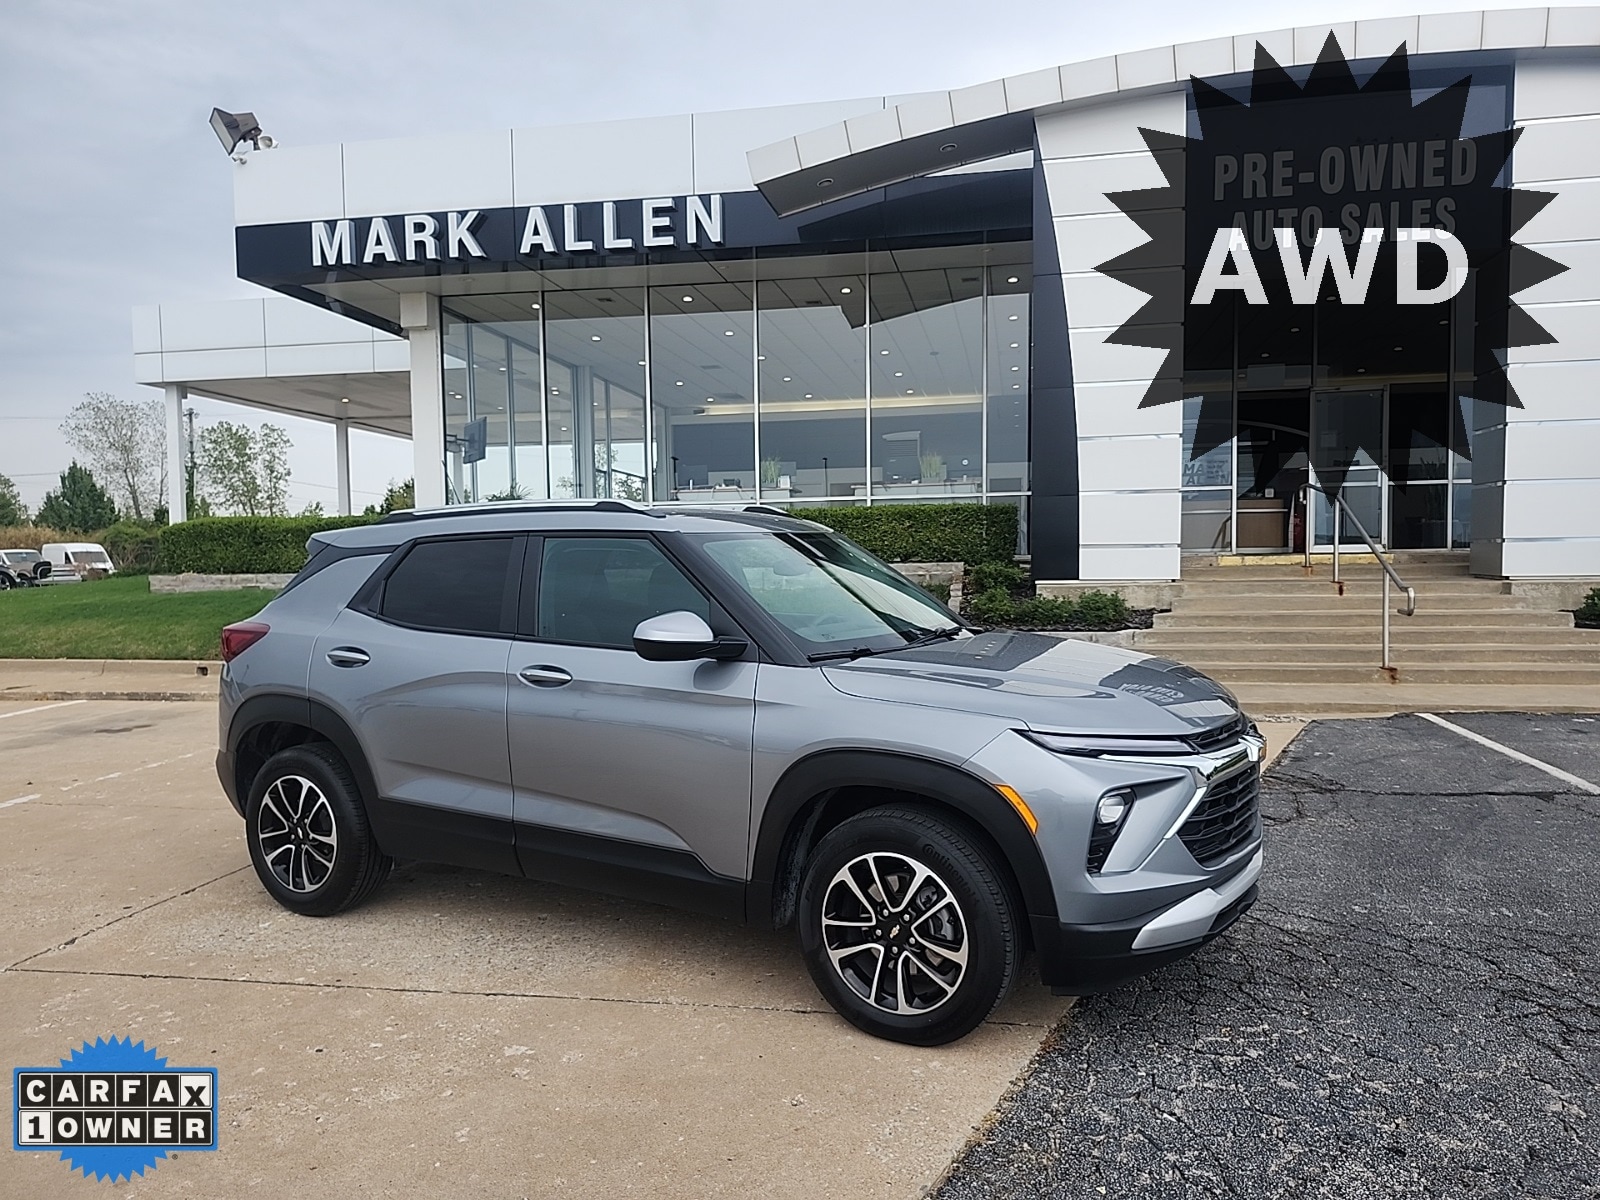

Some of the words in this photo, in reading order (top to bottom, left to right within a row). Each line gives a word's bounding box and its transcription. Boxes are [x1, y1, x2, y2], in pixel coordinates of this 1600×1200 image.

[1214, 138, 1477, 201] PRE-OWNED
[311, 210, 486, 267] MARK
[519, 194, 724, 255] ALLEN
[1230, 204, 1324, 251] AUTO
[1340, 196, 1457, 245] SALES
